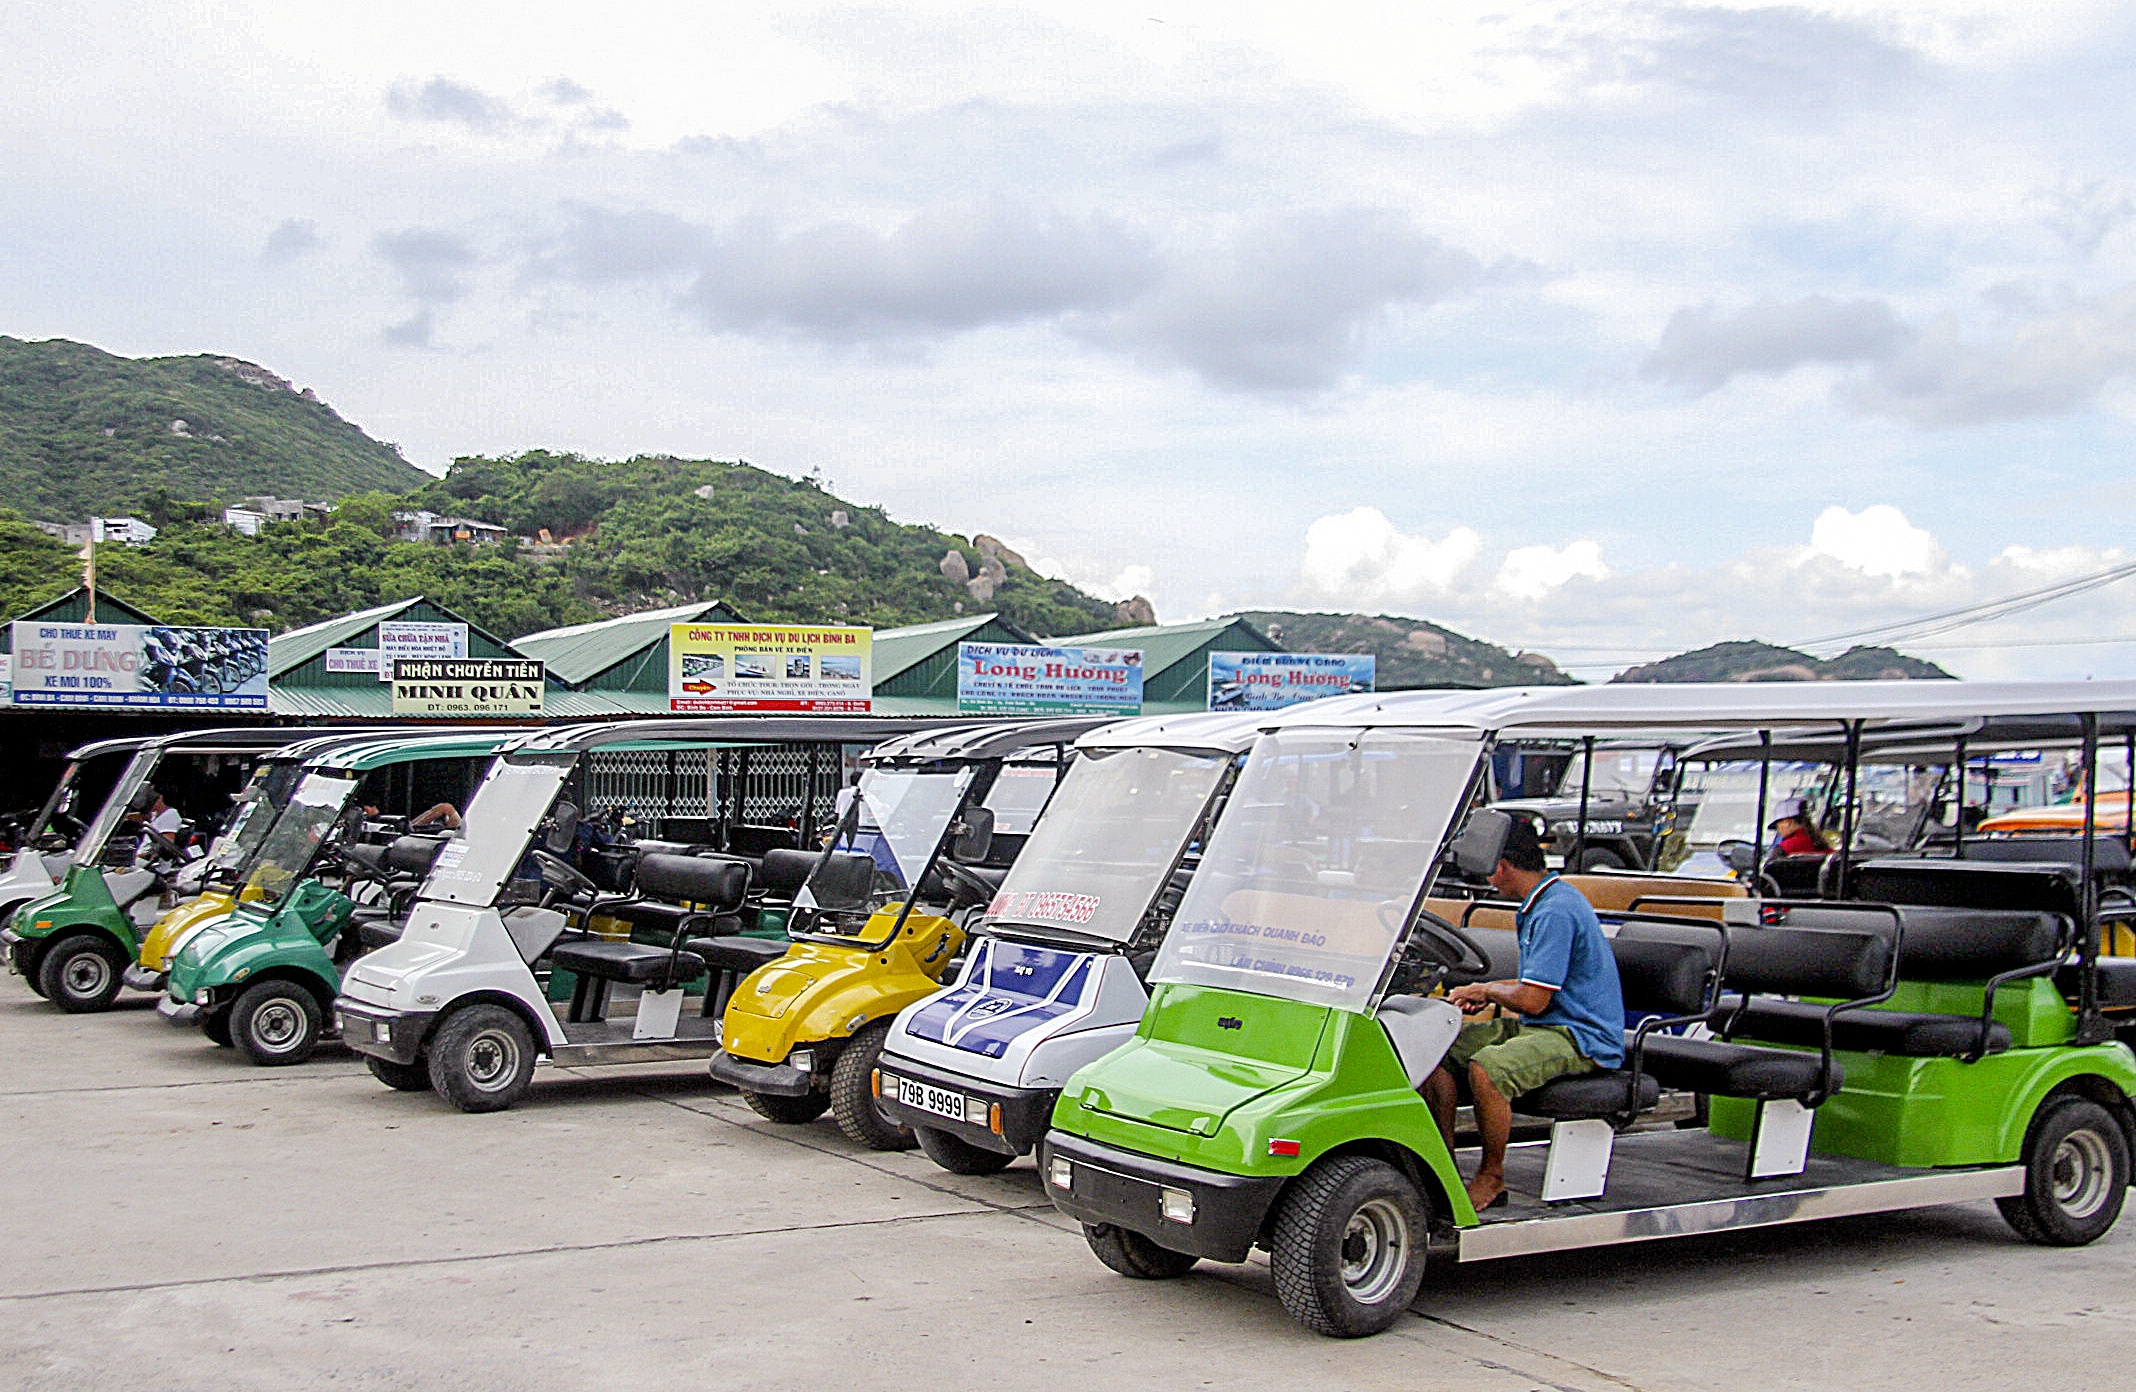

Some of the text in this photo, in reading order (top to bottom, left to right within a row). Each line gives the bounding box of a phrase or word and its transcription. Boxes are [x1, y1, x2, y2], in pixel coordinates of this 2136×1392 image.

[84, 629, 95, 639] XE
[688, 628, 856, 645] CÔNG TY TNHH DỊCH VỤ DU LỊCH BÌNH BA
[734, 645, 757, 653] PHÒNG
[328, 659, 345, 670] CHO
[367, 659, 379, 670] XE
[401, 660, 539, 679] NHẬN CHUYỂN TIỀN
[974, 660, 1128, 684] Long Hương
[45, 675, 58, 687] XE
[83, 676, 112, 688] 100%
[1234, 669, 1351, 688] Long Hương
[397, 683, 539, 702] MINH QUÂN
[1263, 926, 1300, 941] QUANH
[901, 1081, 961, 1117] 79B 9999
